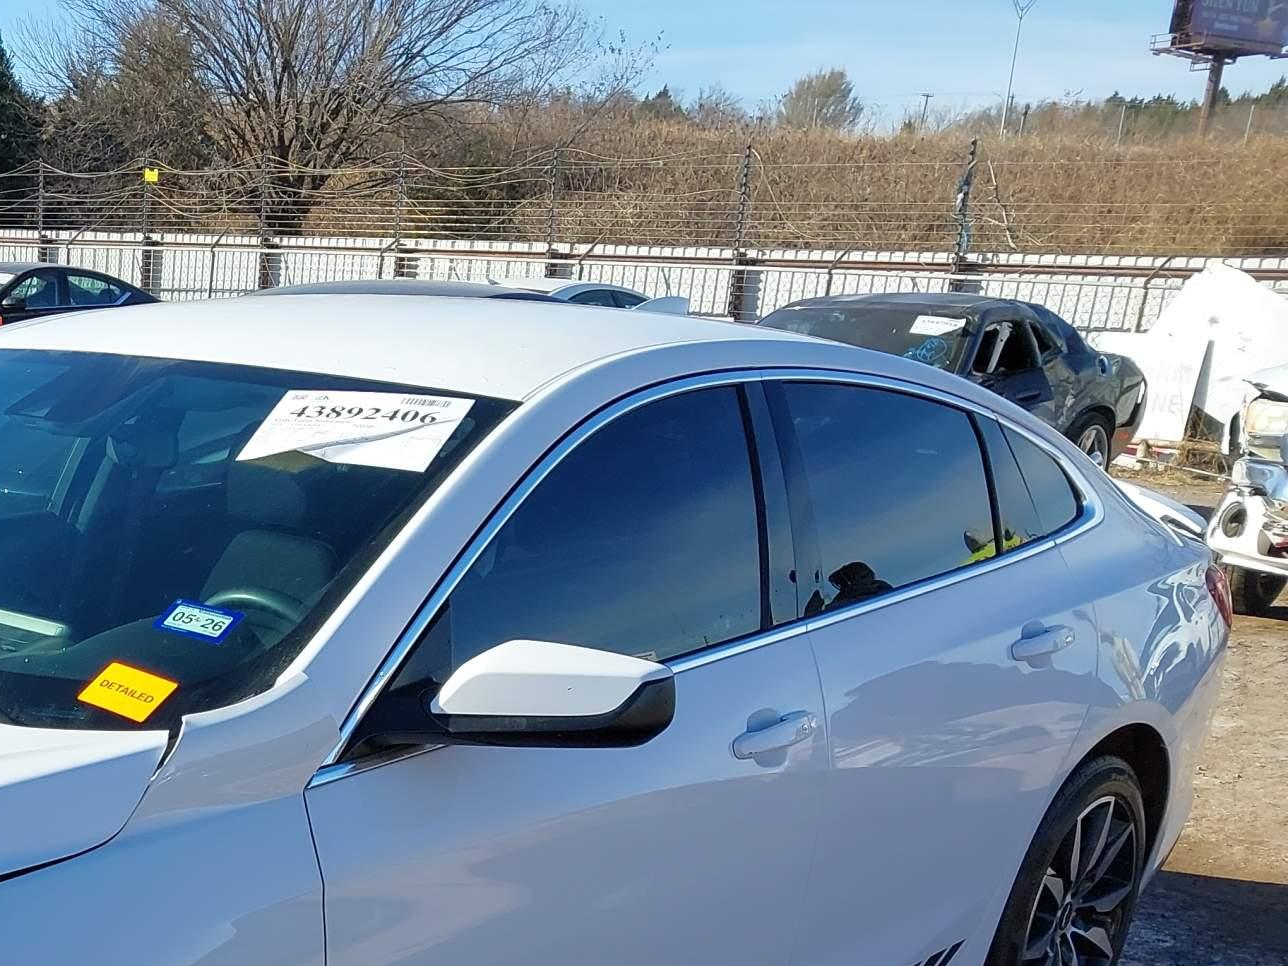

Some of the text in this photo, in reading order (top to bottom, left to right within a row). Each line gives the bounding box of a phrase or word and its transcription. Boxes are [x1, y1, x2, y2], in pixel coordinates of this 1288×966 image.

[289, 404, 441, 425] 43892406
[172, 611, 197, 625] 05
[200, 617, 227, 632] 26
[99, 679, 155, 704] DETAILED
